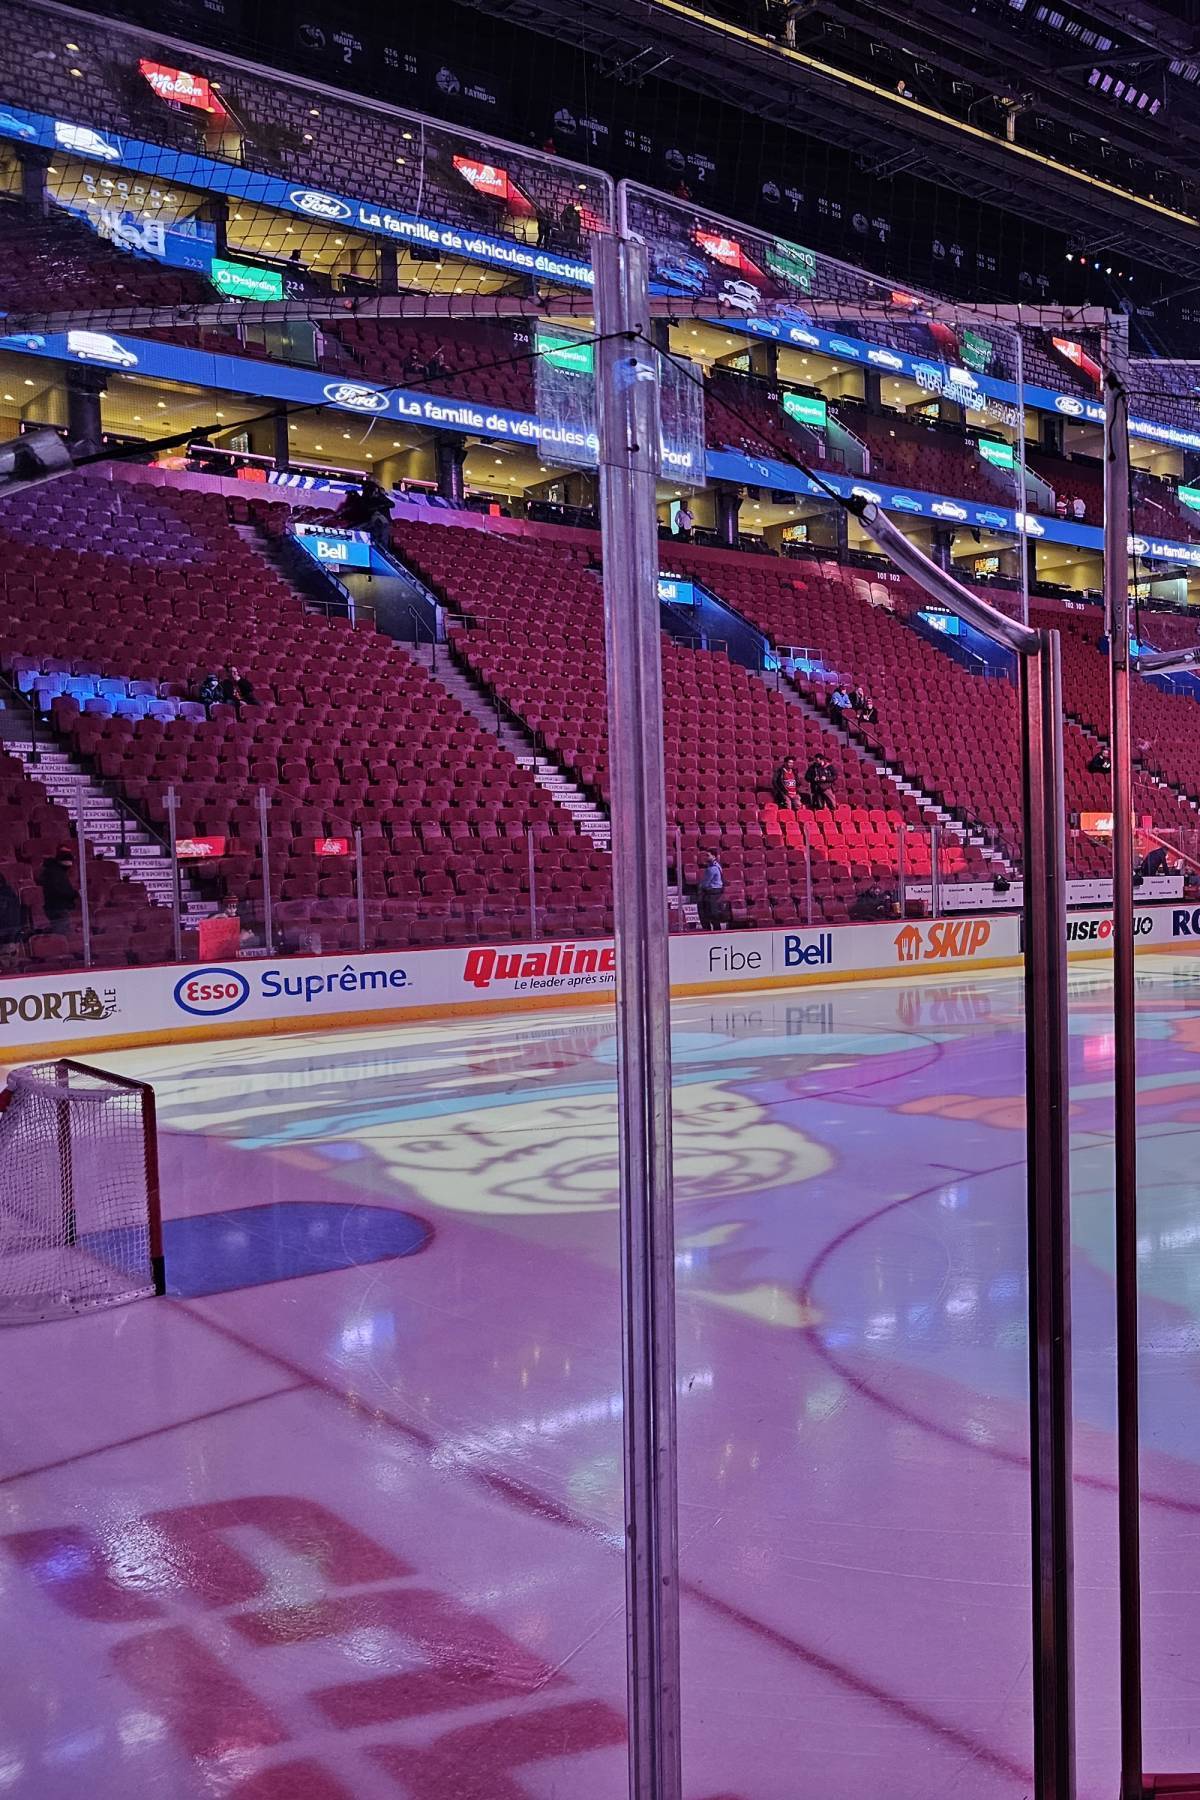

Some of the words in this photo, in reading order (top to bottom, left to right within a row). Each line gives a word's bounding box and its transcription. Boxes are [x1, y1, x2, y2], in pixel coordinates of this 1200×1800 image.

[344, 47, 352, 64] 2
[150, 72, 202, 97] Molson
[460, 165, 503, 187] Molson
[301, 193, 339, 217] Ford
[359, 208, 380, 226] La
[382, 214, 439, 244] famille
[441, 231, 462, 249] de
[463, 239, 534, 269] véhicules
[536, 255, 596, 285] électrifié
[286, 280, 304, 291] 224
[513, 333, 528, 343] 224
[767, 392, 778, 400] 201
[335, 386, 380, 408] Ford
[399, 397, 422, 414] La
[425, 403, 484, 427] famille
[486, 414, 507, 432] de
[510, 418, 584, 445] véhicules
[827, 406, 839, 415] 202
[660, 449, 692, 468] Ford
[317, 541, 348, 560] Bell
[1152, 543, 1163, 554] La
[1163, 545, 1191, 560] famille
[1191, 552, 1200, 561] de
[889, 573, 900, 582] 102
[784, 933, 832, 966] Bell
[924, 920, 991, 958] SKIP
[463, 944, 617, 988] Qualine
[709, 945, 761, 972] Fibe
[187, 981, 239, 1002] Esso
[262, 964, 407, 1002] Suprême
[514, 980, 527, 990] Le
[529, 977, 565, 989] leader
[567, 974, 596, 987] après
[107, 987, 117, 1013] ALE
